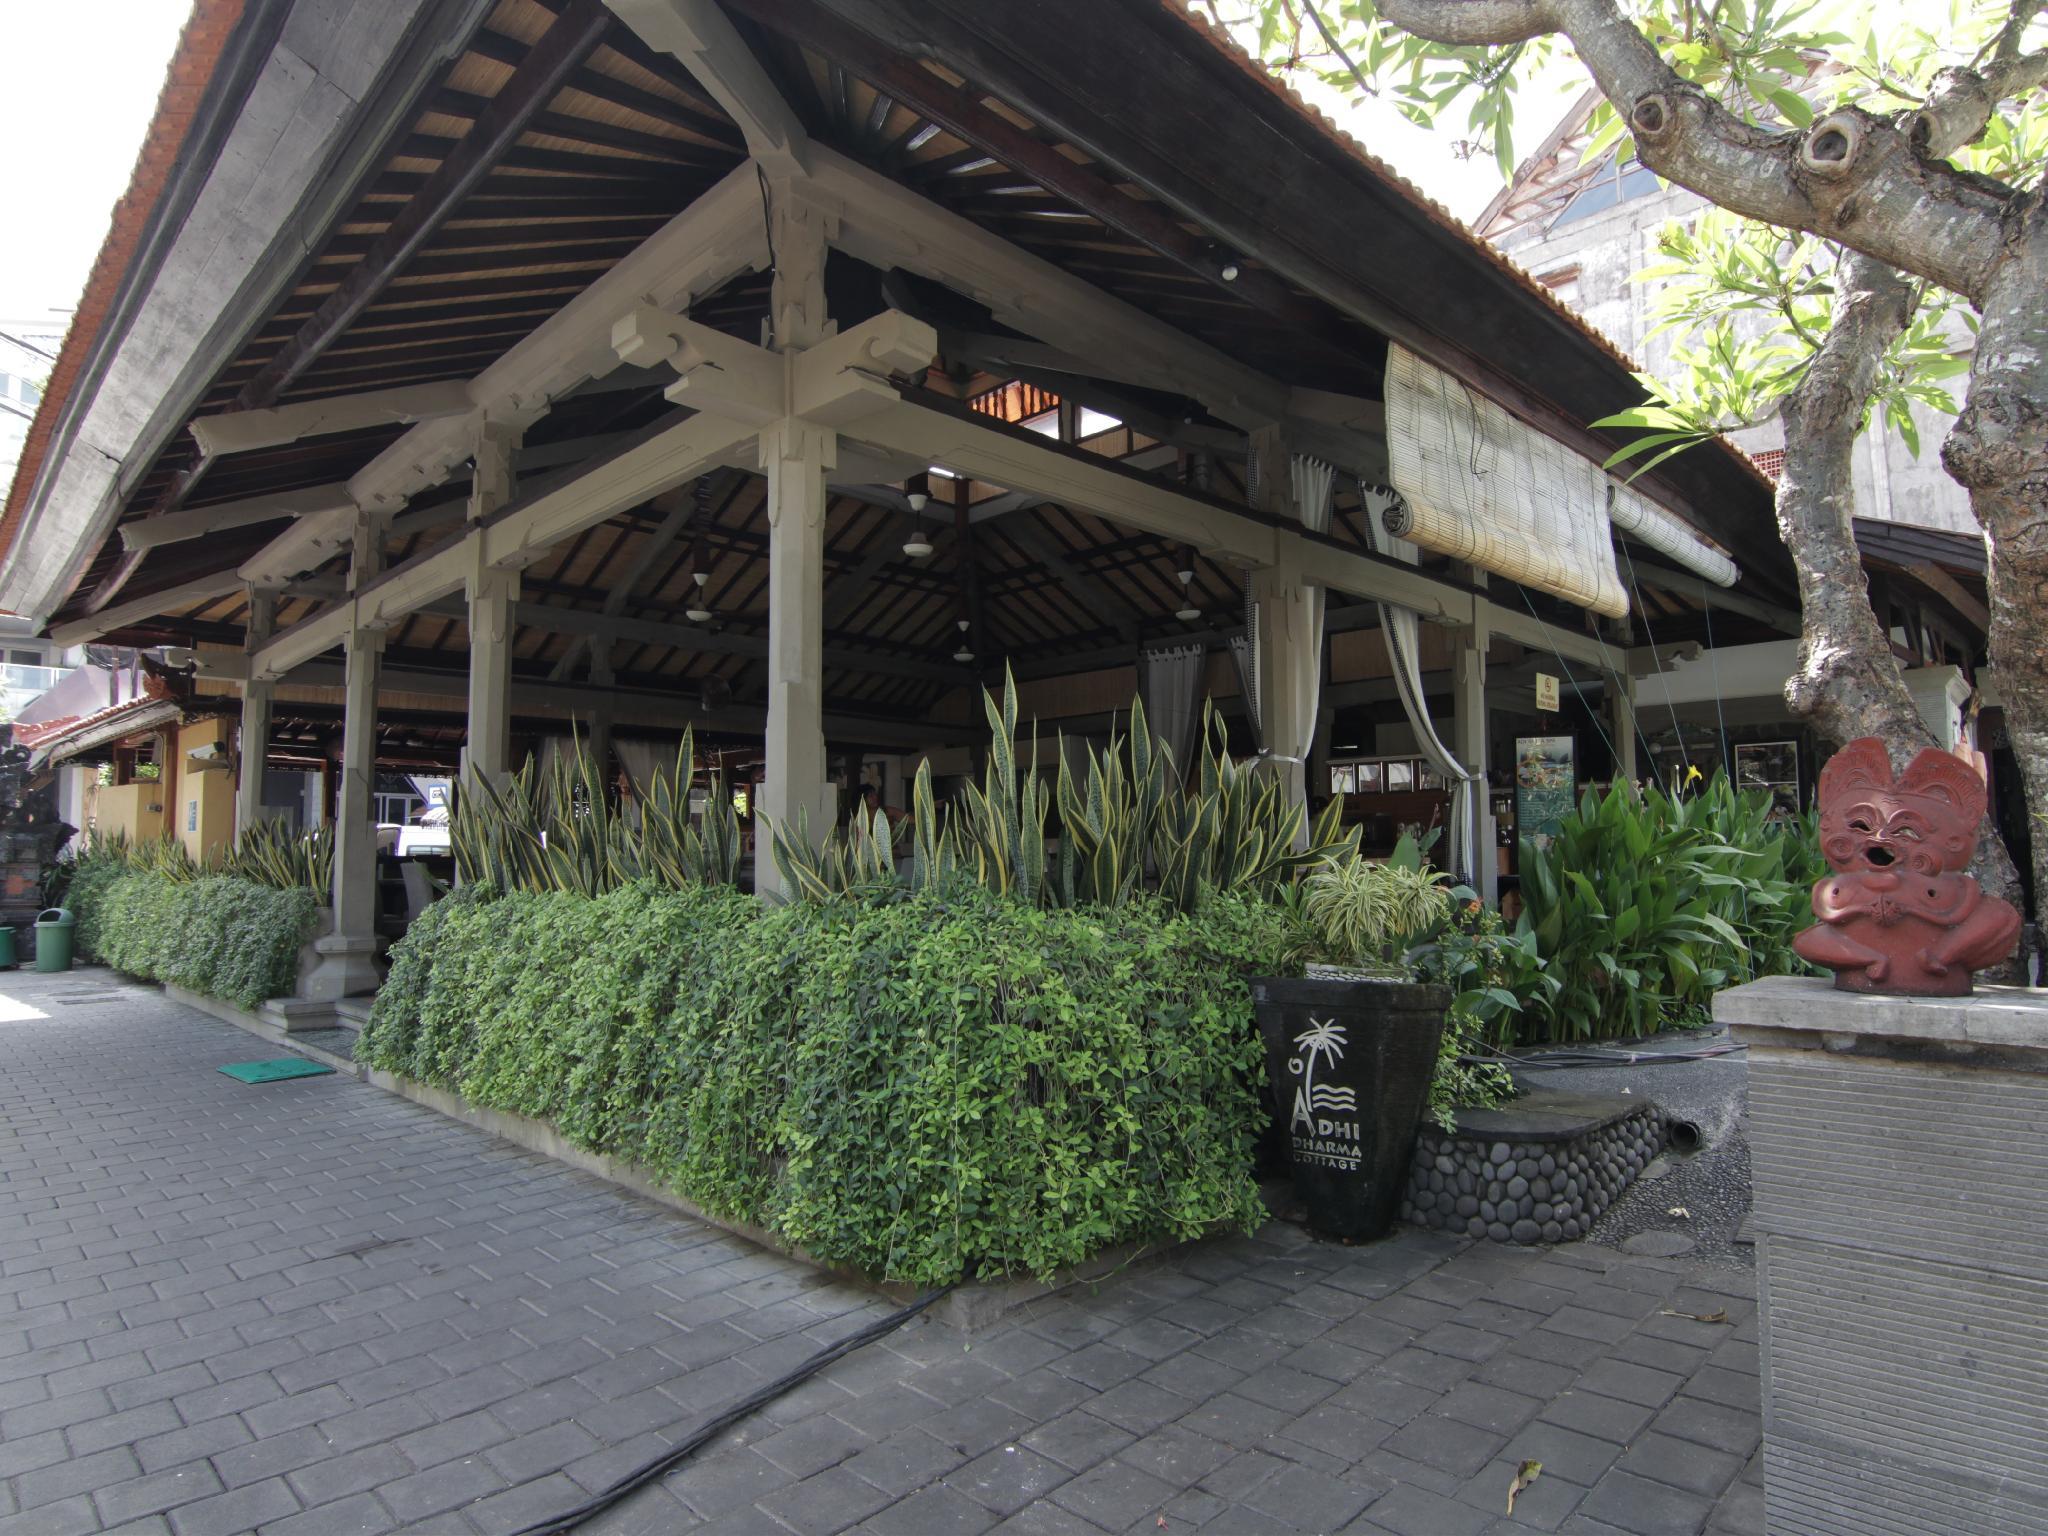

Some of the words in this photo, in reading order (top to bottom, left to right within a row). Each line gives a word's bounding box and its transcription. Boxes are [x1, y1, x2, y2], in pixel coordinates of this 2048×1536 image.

[1290, 1086, 1360, 1140] ADHI
[1292, 1137, 1362, 1158] DHARMA
[1293, 1154, 1357, 1171] COTTAGE
